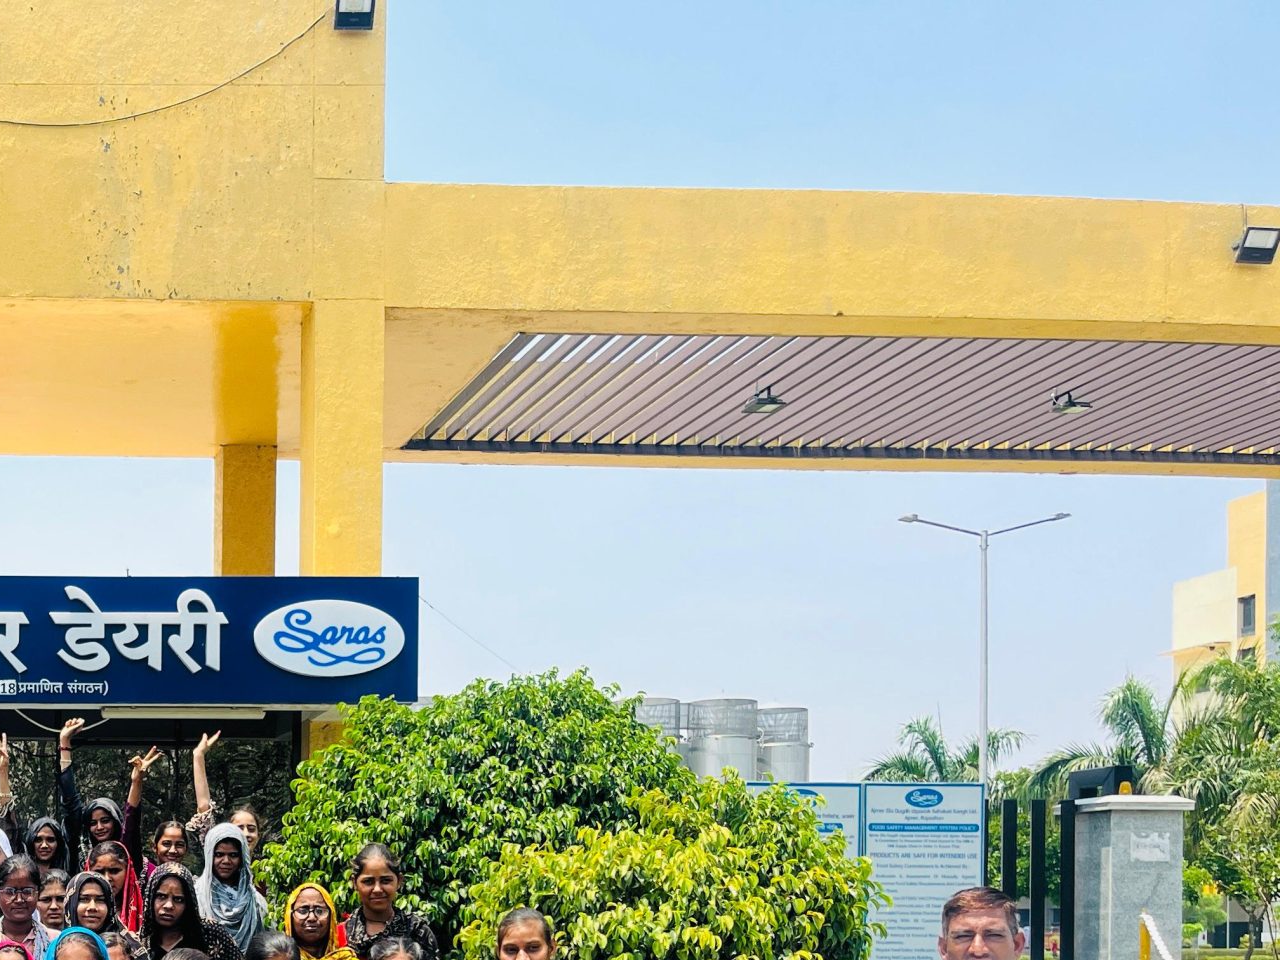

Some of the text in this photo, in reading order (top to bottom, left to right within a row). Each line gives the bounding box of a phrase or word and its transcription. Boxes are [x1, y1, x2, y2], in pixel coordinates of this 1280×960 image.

[48, 584, 229, 674] डेयरी
[273, 608, 386, 667] Saras
[18, 679, 63, 694] प्रमाणित
